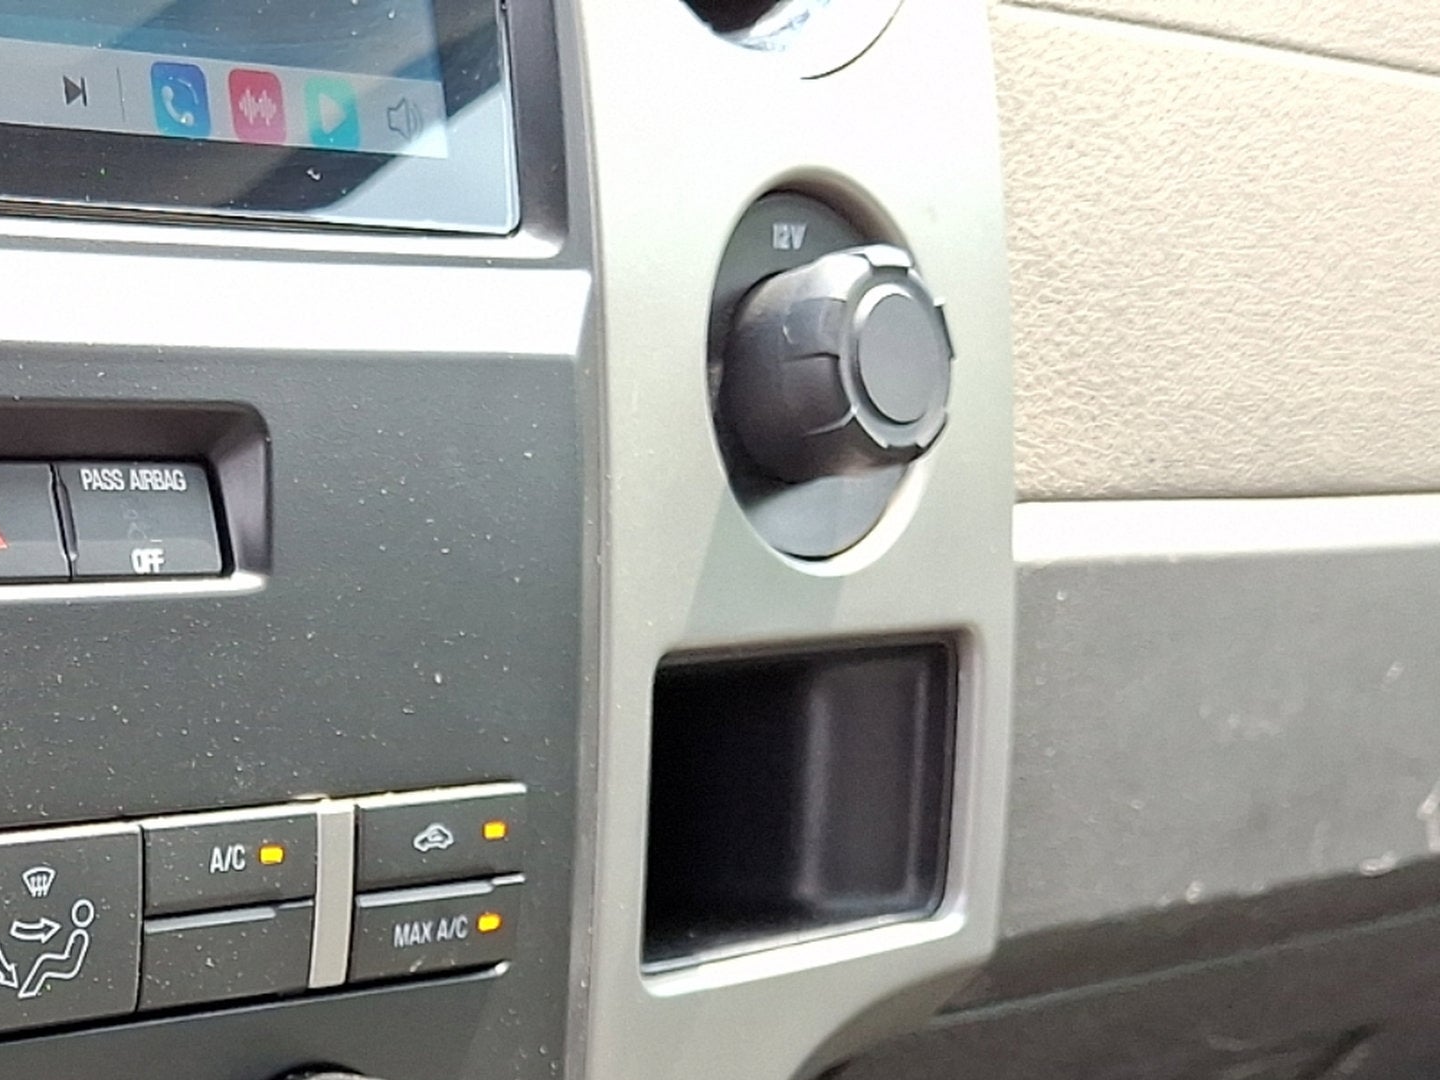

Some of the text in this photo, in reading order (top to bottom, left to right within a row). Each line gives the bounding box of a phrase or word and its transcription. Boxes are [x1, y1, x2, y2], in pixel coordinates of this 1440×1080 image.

[772, 223, 807, 249] 12V
[80, 468, 187, 491] PASS AIRBAG
[131, 548, 165, 574] OFF
[210, 844, 246, 873] A/C
[394, 915, 469, 947] MAX A/C
